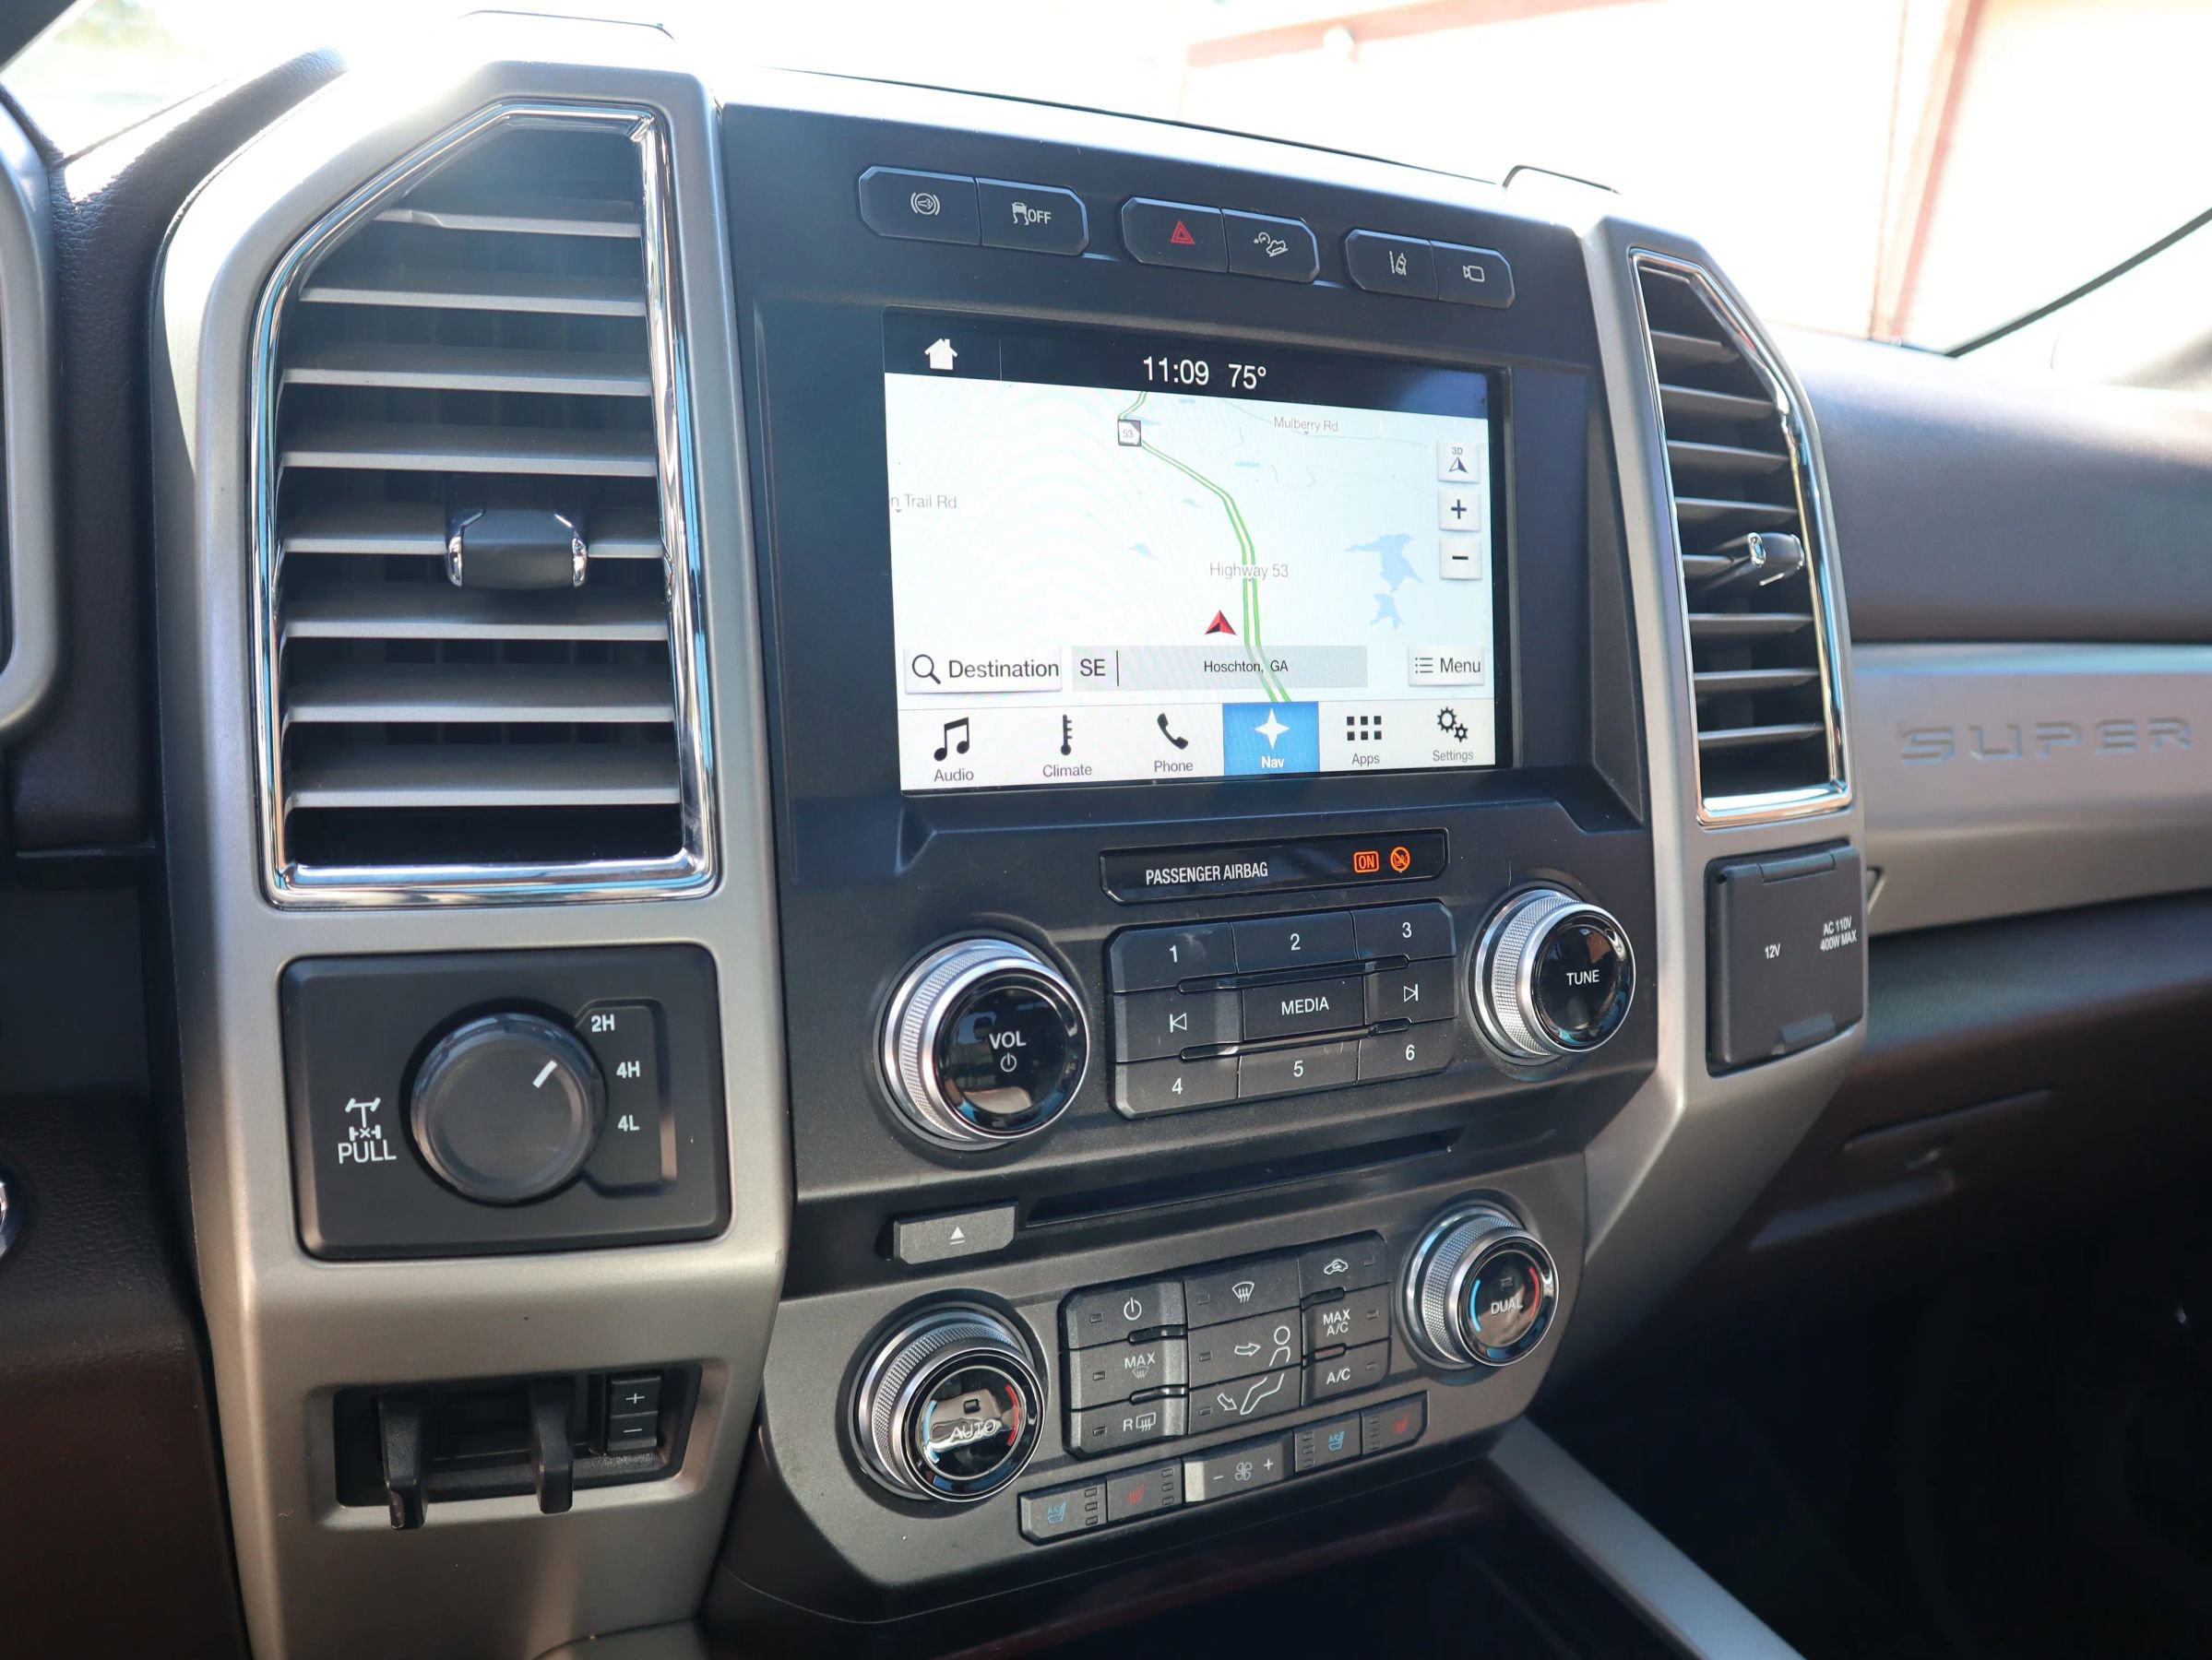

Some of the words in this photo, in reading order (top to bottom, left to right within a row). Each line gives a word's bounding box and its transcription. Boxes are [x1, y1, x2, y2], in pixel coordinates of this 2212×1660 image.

[1028, 208, 1052, 224] OFF
[1143, 356, 1210, 386] 11:09
[1229, 363, 1267, 390] 75°
[1274, 416, 1320, 434] Mulberry
[1325, 421, 1338, 432] Rd
[1123, 429, 1133, 439] 53
[1452, 446, 1463, 456] 3D
[904, 493, 933, 508] Trail
[937, 495, 957, 509] Rd
[1209, 563, 1268, 583] Highway
[1272, 564, 1289, 577] 53
[948, 659, 1059, 679] Destination
[1079, 658, 1106, 677] SE
[1203, 659, 1264, 674] Hoschton,
[1270, 659, 1289, 672] GA
[1440, 658, 1481, 673] Menu
[1898, 717, 2194, 765] SUPER
[1261, 756, 1285, 769] Nav
[1351, 753, 1380, 765] Apps
[1432, 750, 1474, 764] Settings
[934, 768, 974, 782] Audio
[1042, 765, 1092, 777] Climate
[1154, 760, 1194, 773] Phone
[1358, 854, 1375, 869] ON
[1145, 868, 1220, 885] PASSENGER
[1223, 861, 1268, 880] AIRBAG
[1401, 922, 1412, 939] 3
[1823, 923, 1834, 936] AC
[1836, 917, 1852, 931] 110V
[1290, 933, 1301, 951] 2
[1820, 934, 1840, 952] 400W
[1841, 930, 1857, 945] MAX
[1169, 944, 1178, 963] 1
[1765, 944, 1780, 959] 12V
[1565, 969, 1600, 986] TUNE
[1280, 997, 1329, 1015] MEDIA
[590, 1015, 614, 1032] 2H
[989, 1031, 1026, 1049] VOL
[1405, 1044, 1415, 1061] 6
[616, 1061, 640, 1078] 4H
[1293, 1061, 1303, 1077] 5
[1171, 1079, 1183, 1095] 4
[617, 1116, 639, 1132] 4L
[338, 1140, 396, 1164] PULL
[1491, 1297, 1523, 1315] DUAL
[1323, 1309, 1350, 1325] MAX
[1326, 1322, 1349, 1336] A/C
[1124, 1352, 1156, 1369] MAX
[1326, 1368, 1351, 1385] A/C
[949, 1417, 997, 1443] AUTO
[1123, 1419, 1133, 1431] R
